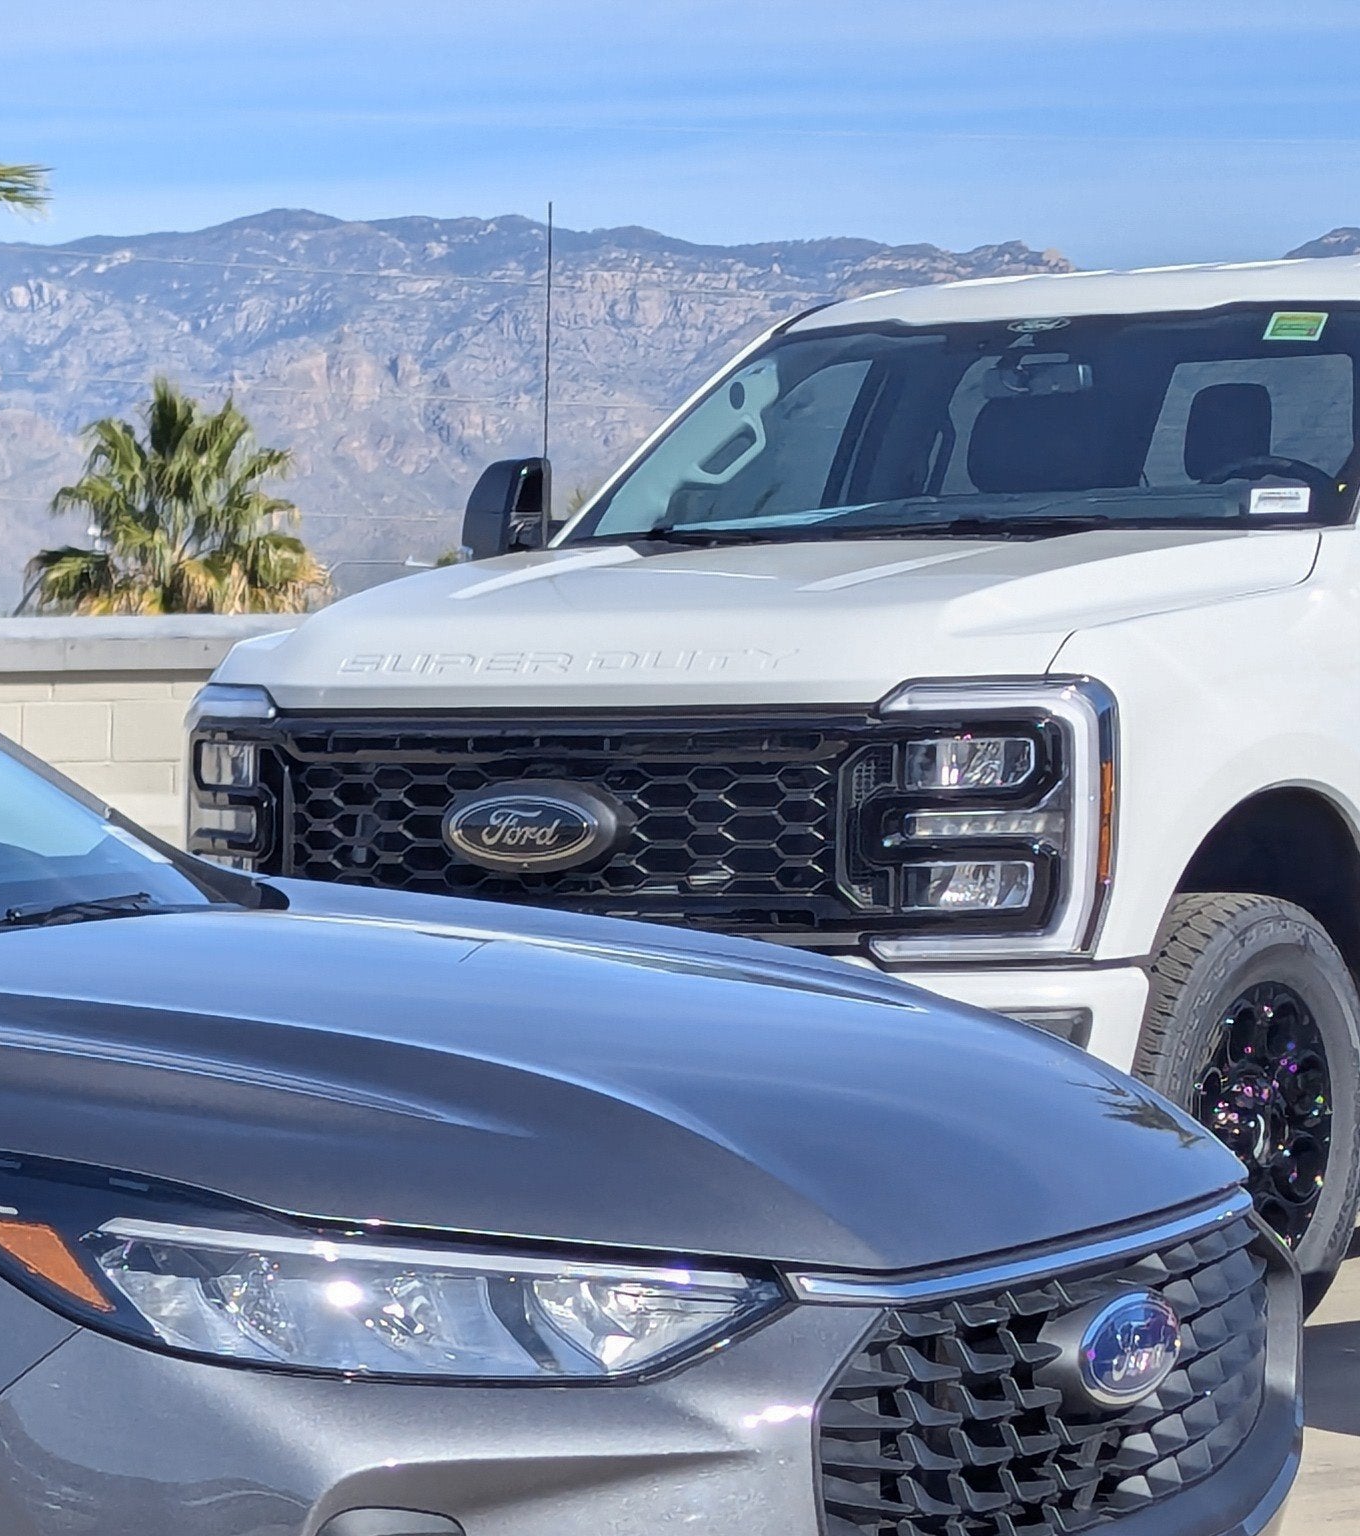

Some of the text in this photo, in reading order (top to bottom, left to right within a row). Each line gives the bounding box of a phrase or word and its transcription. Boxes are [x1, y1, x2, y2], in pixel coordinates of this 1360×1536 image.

[336, 646, 801, 676] SUPER DUTY
[481, 808, 561, 846] Ford
